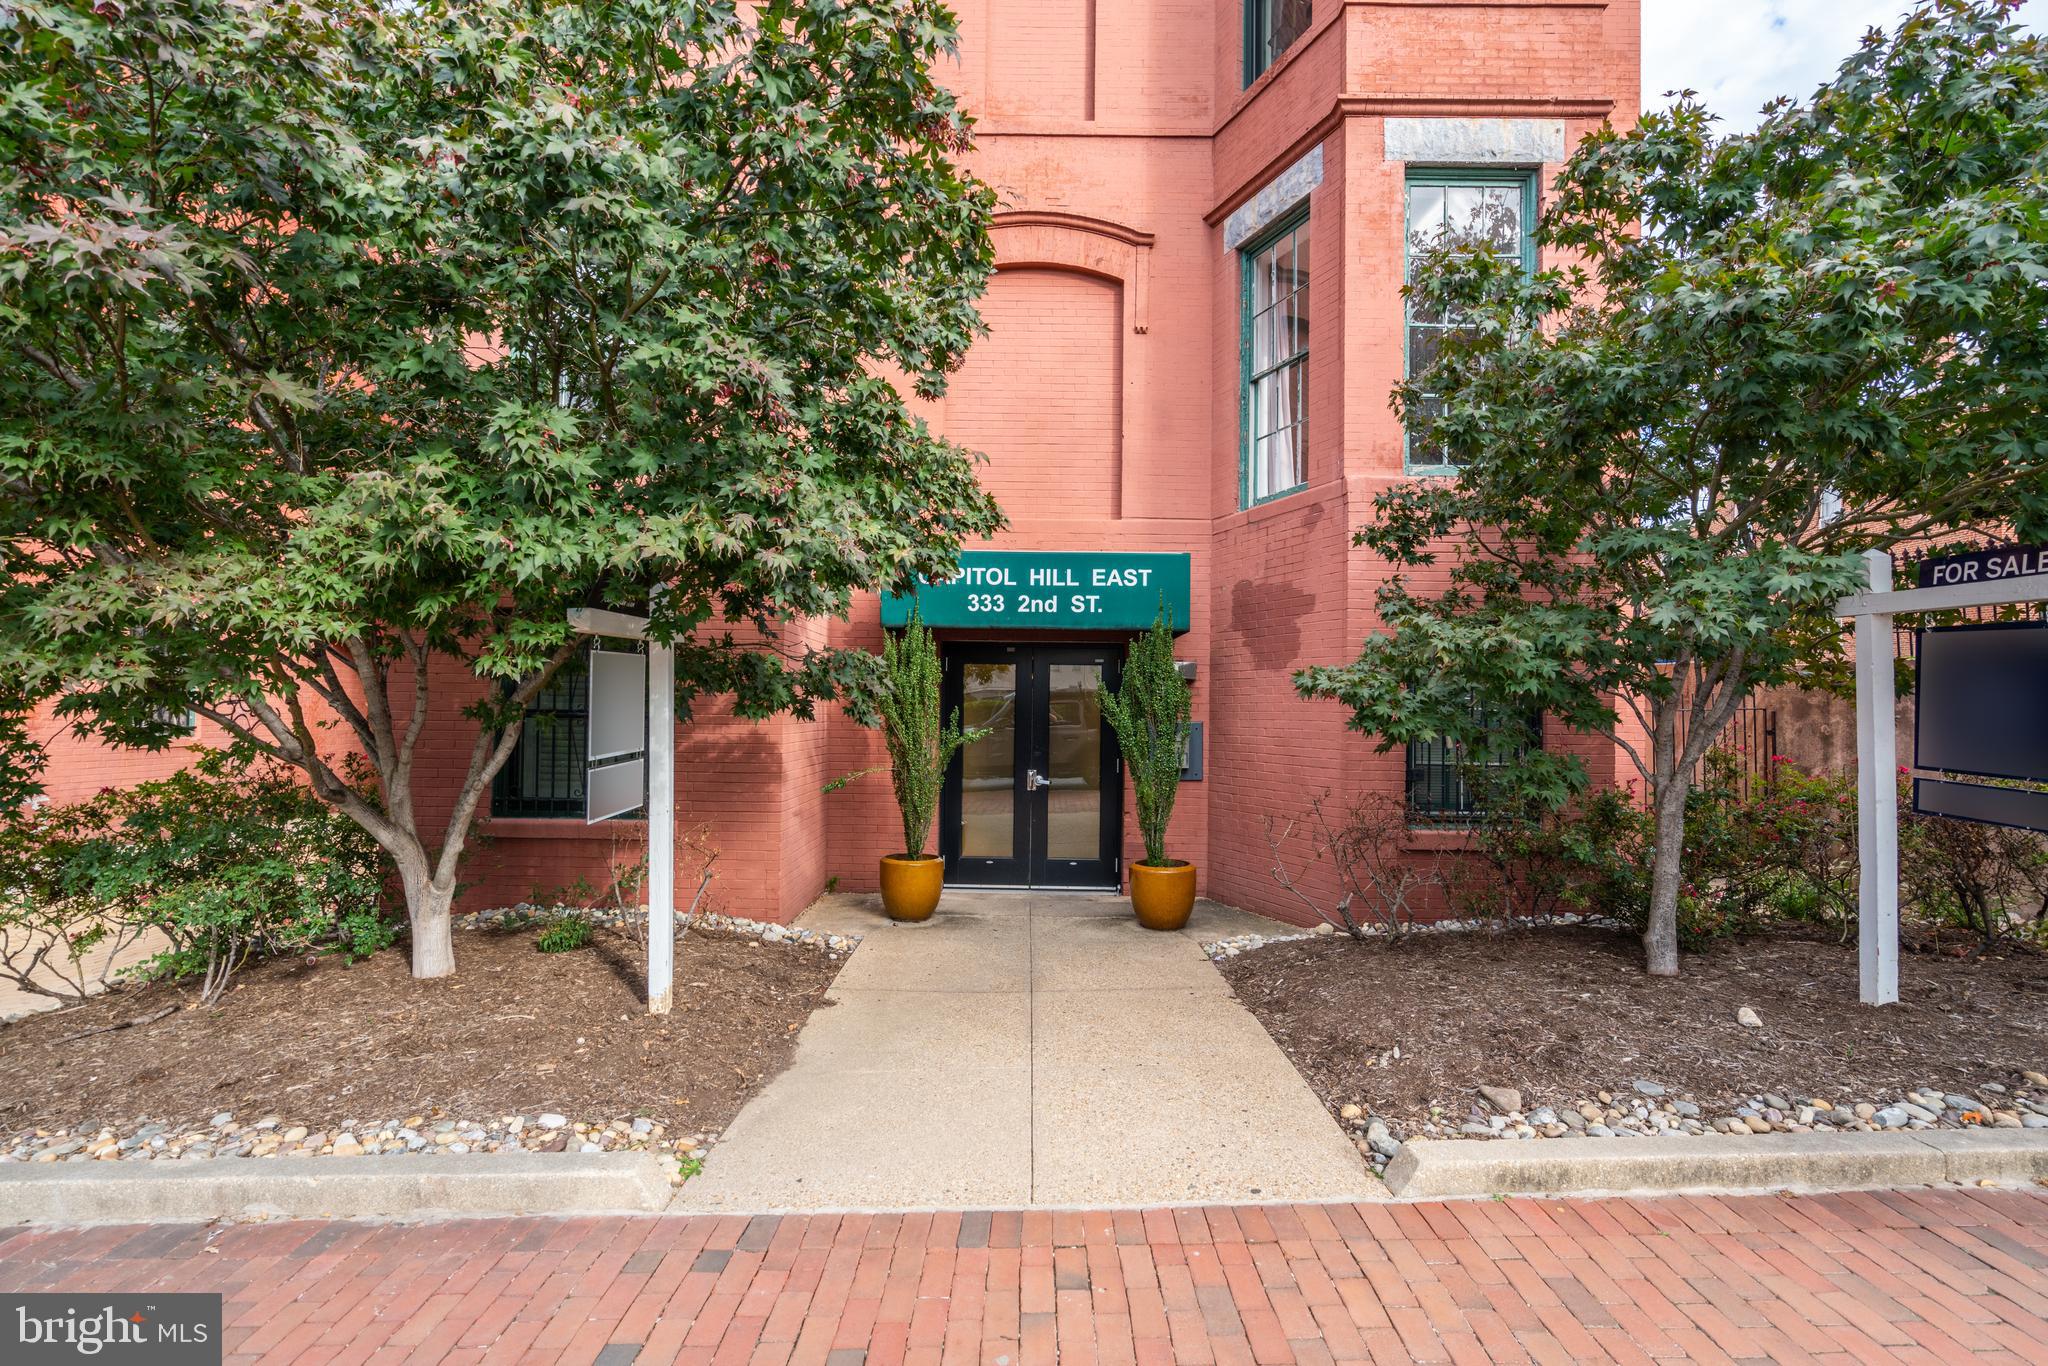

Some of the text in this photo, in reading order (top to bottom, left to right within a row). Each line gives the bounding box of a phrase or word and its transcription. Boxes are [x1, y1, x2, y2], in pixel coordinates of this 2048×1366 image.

[1029, 568, 1080, 586] HILL
[1092, 568, 1153, 587] EAST
[1932, 551, 2048, 585] FOR SALE
[967, 593, 1103, 613] 333 2nd ST.
